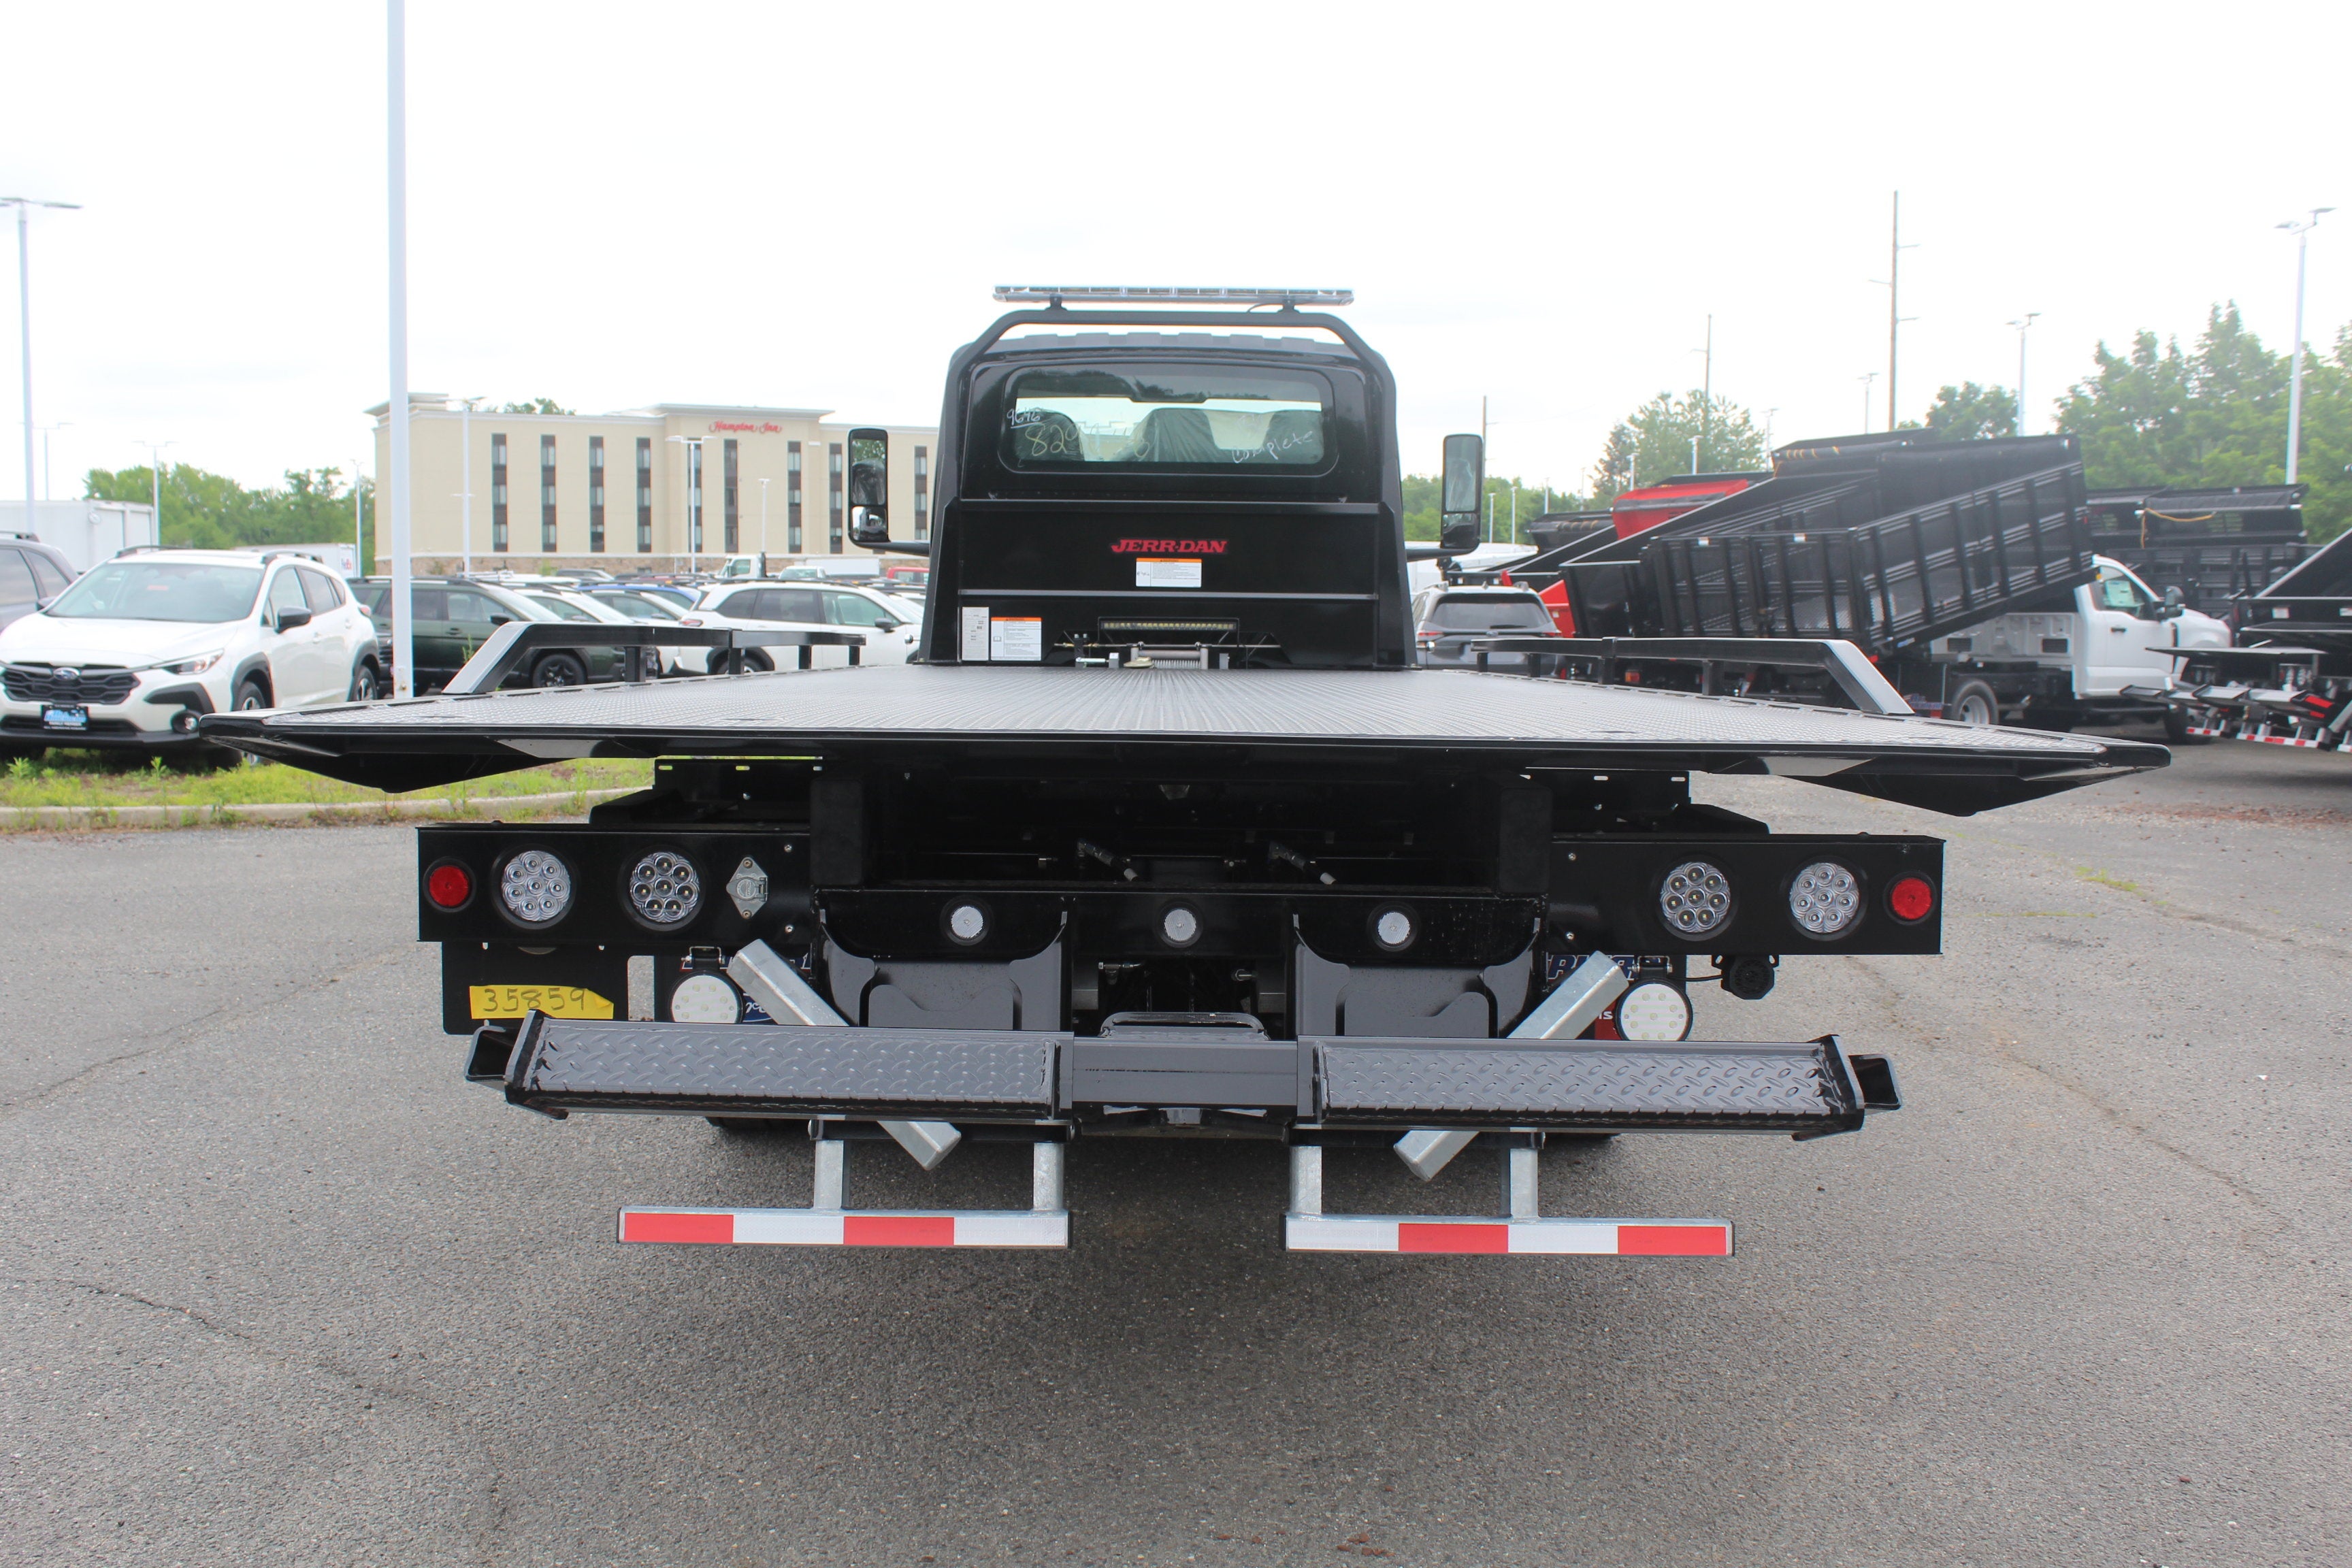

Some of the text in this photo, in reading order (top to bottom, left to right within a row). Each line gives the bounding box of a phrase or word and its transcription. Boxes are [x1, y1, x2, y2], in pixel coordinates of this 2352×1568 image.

[708, 420, 782, 434] Hampton Inn
[482, 987, 585, 1013] 35859
